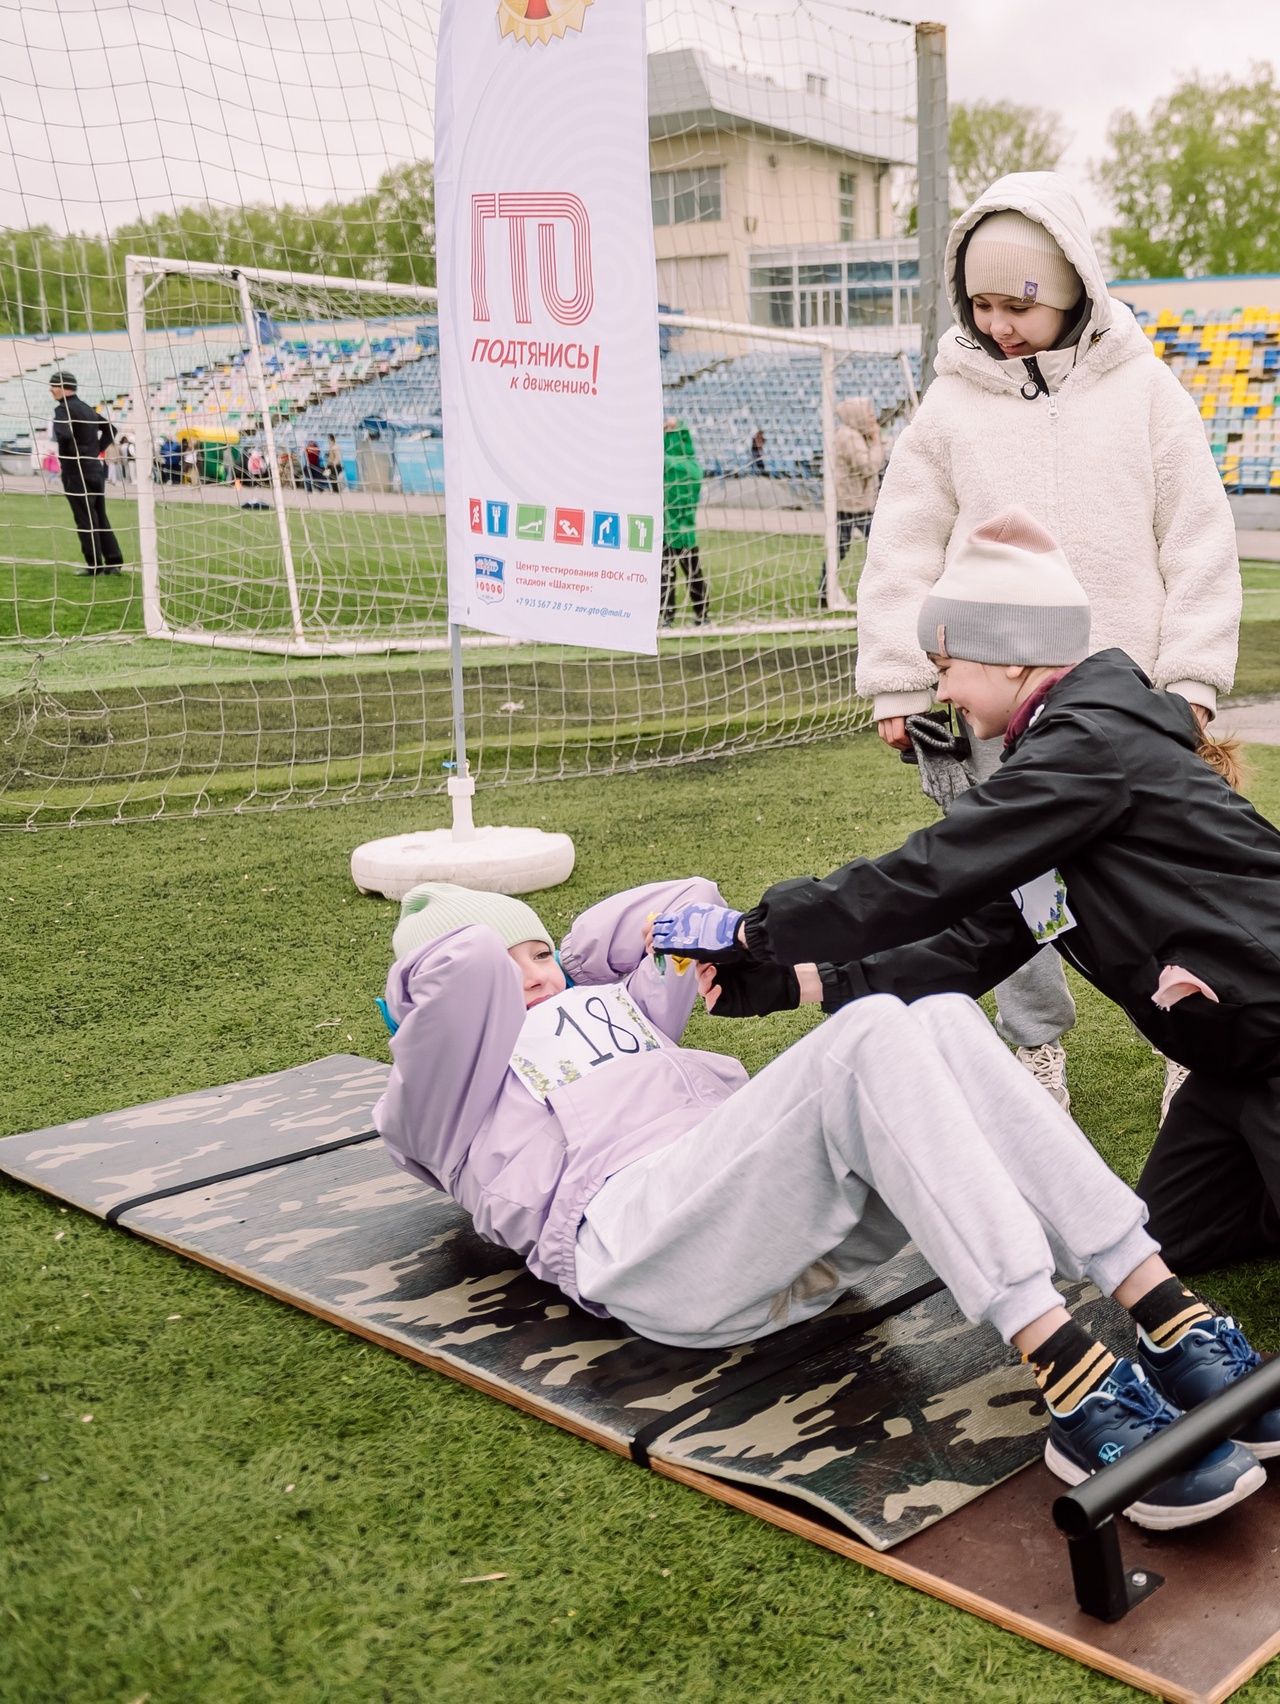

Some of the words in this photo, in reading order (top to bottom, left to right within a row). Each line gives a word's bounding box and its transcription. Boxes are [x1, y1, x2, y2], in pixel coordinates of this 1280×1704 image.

[470, 191, 594, 327] ГТО
[510, 375, 520, 391] к
[522, 376, 591, 396] движению
[515, 560, 539, 573] Центр
[541, 565, 598, 579] тестирования
[600, 569, 625, 581] ВФСК
[515, 576, 546, 588] стадион
[537, 600, 551, 608] 567
[552, 601, 562, 610] 28
[563, 603, 573, 611] 57
[554, 996, 640, 1067] 18
